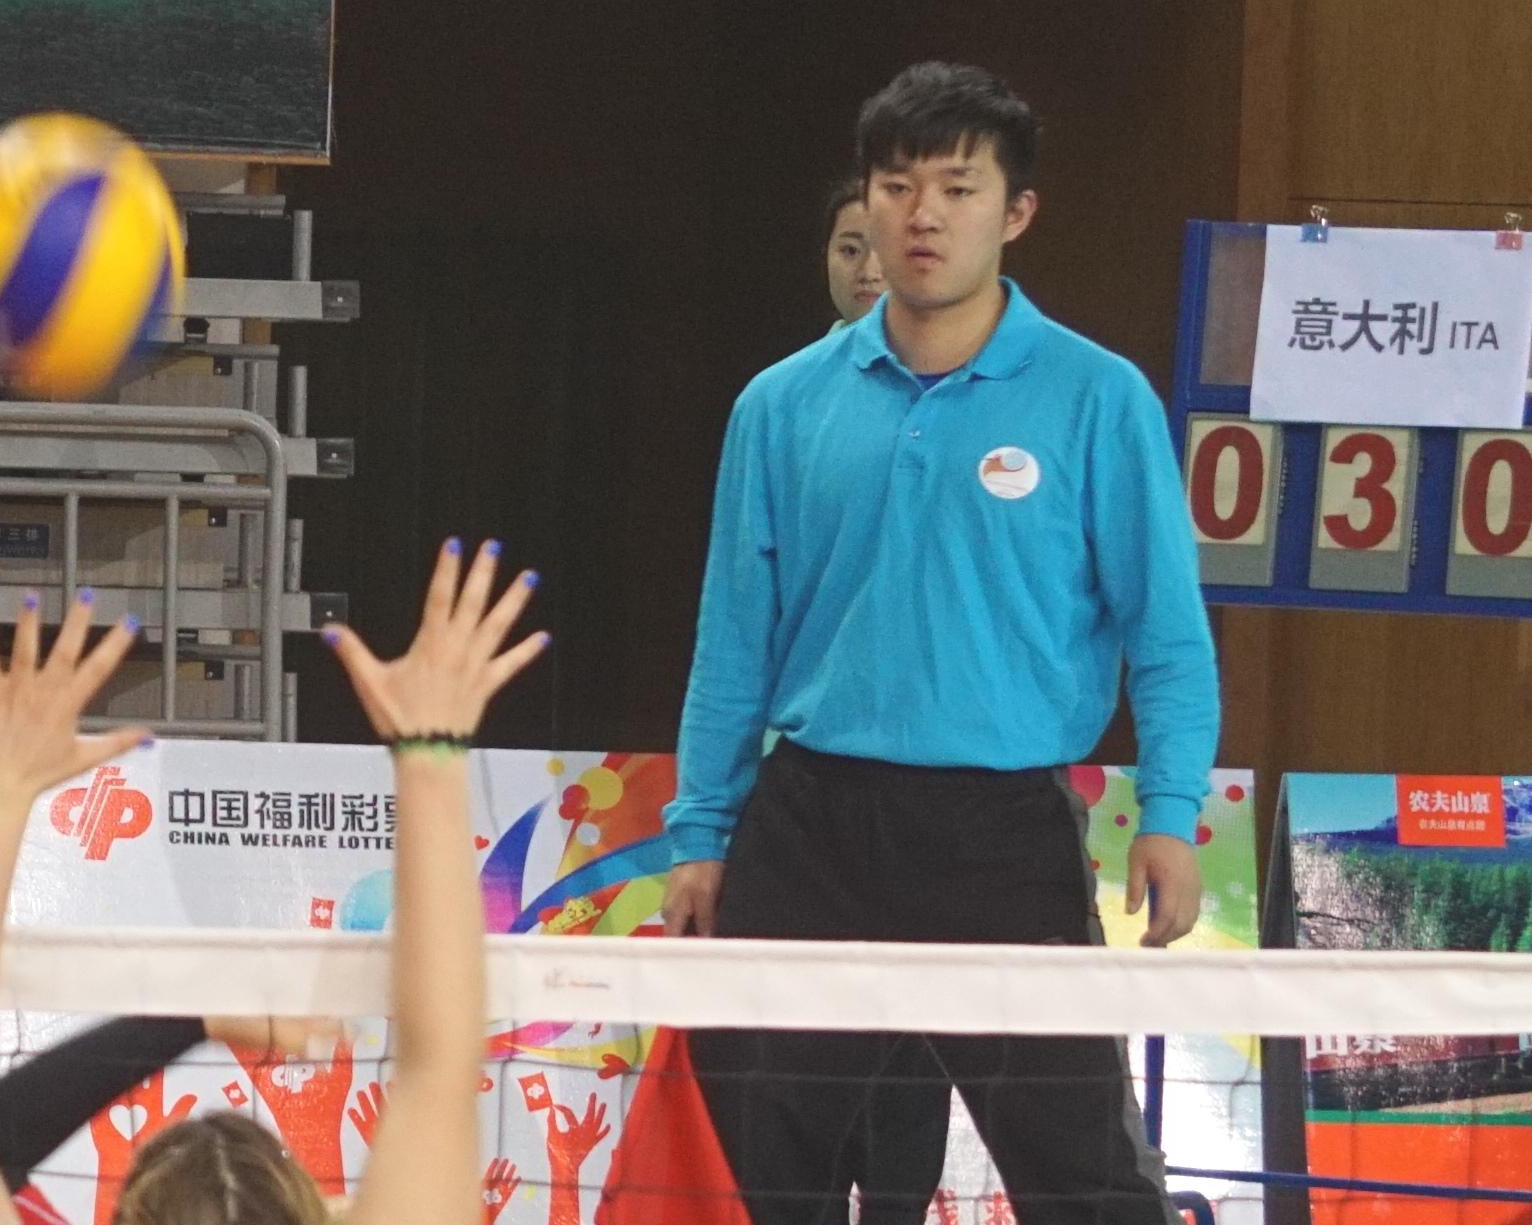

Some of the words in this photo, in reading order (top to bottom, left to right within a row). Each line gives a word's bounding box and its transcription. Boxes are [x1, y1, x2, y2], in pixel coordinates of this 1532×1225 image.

[1288, 297, 1439, 355] 意大利
[1448, 320, 1500, 351] ITA
[1190, 425, 1264, 541] 0
[1323, 432, 1397, 551] 3
[1462, 438, 1532, 557] 0
[169, 831, 231, 846] CHINA
[240, 833, 327, 849] WELFARE
